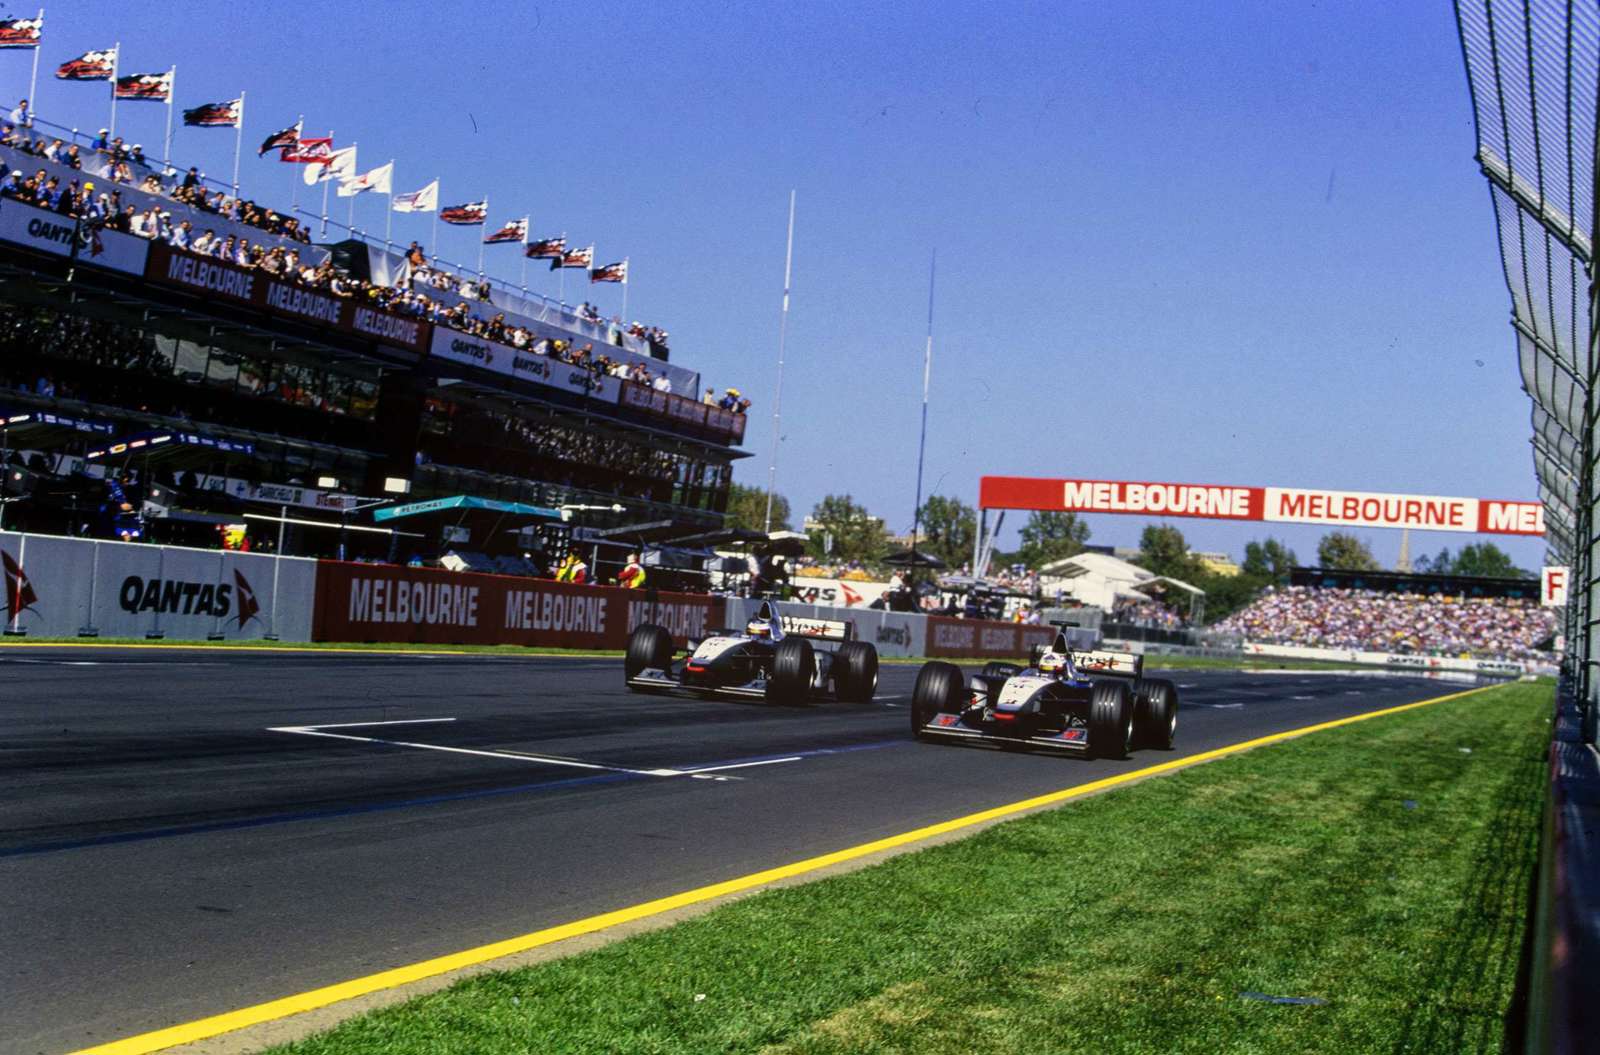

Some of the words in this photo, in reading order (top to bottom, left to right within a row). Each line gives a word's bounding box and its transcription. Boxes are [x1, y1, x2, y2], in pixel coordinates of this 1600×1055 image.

[168, 254, 254, 299] MELBOURNE
[266, 282, 342, 324] MELBOURNE
[451, 339, 485, 359] QANTAS
[1064, 482, 1250, 516] MELBOURNE
[1280, 493, 1464, 526] MELBOURNE
[119, 576, 232, 616] QANTAS
[350, 578, 480, 626] MELBOURNE
[1547, 571, 1563, 600] F
[504, 590, 606, 633] MELBOURNE
